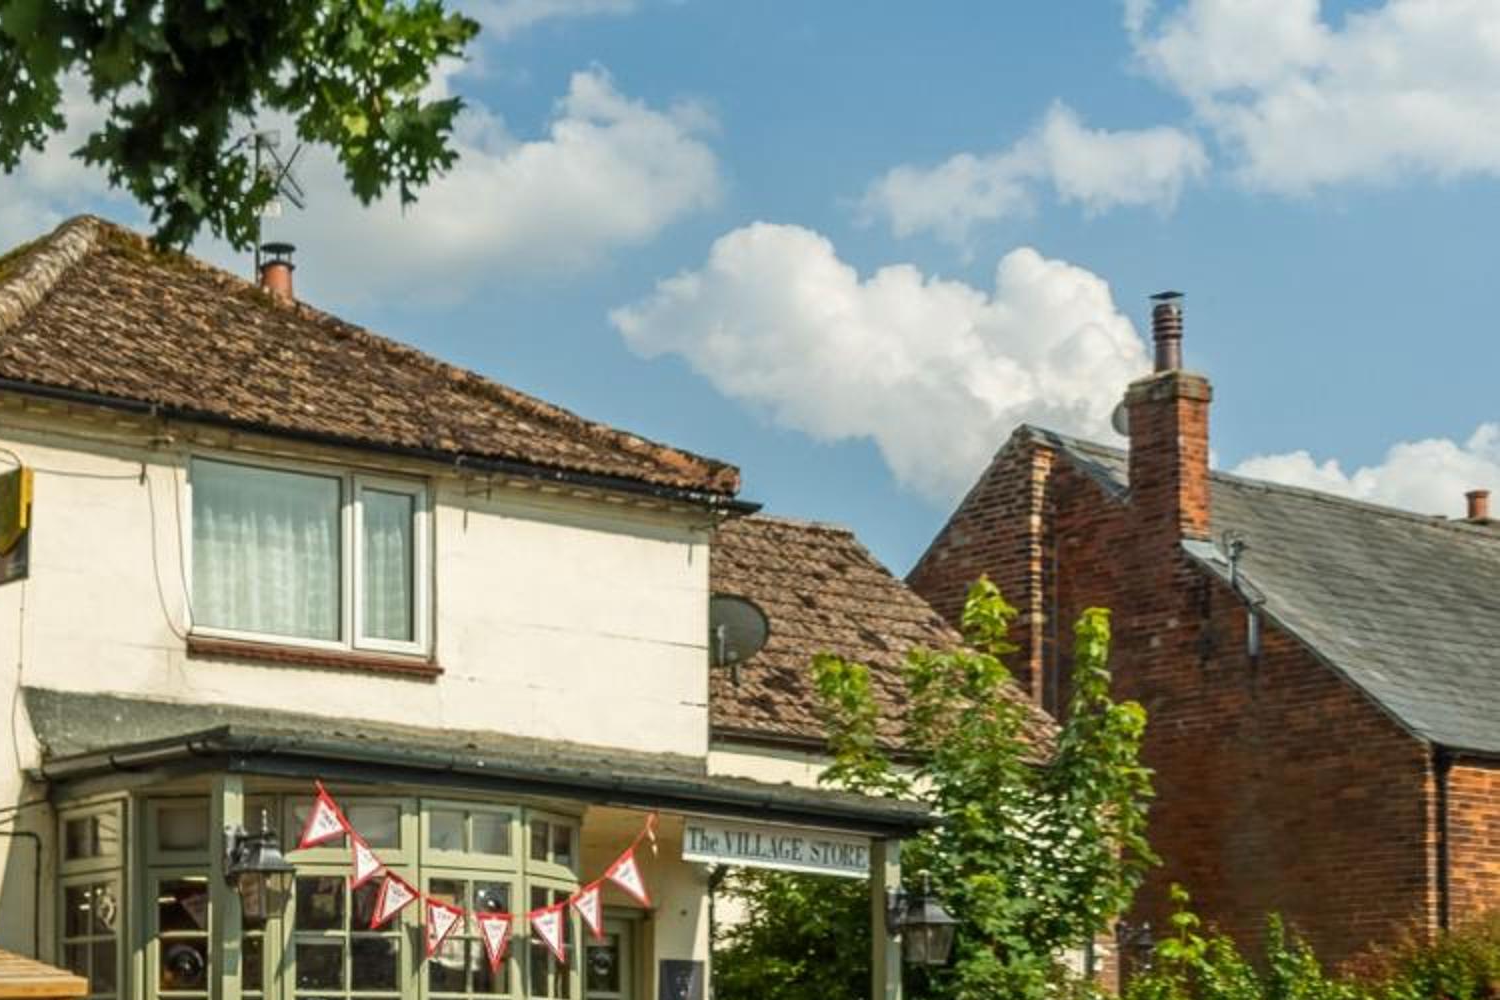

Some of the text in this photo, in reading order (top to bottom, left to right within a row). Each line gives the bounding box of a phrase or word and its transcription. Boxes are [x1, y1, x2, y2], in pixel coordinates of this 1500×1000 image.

[687, 826, 867, 869] The VILLAGE STORE
